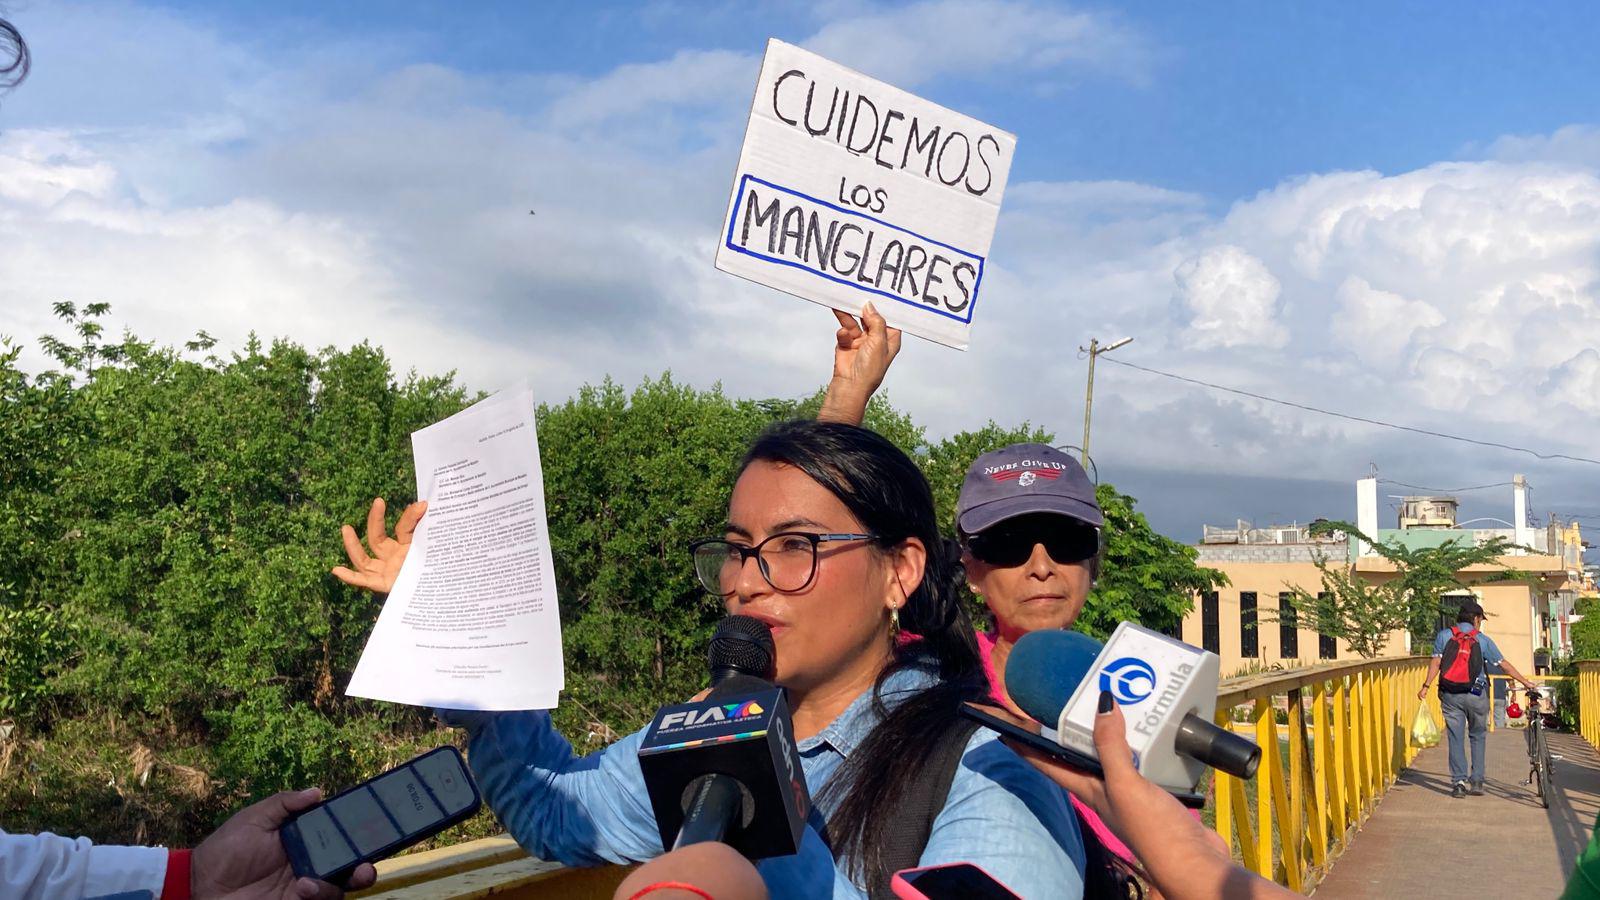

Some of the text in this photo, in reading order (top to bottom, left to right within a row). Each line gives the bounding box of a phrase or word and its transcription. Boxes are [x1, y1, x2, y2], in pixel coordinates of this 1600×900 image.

[773, 69, 1000, 196] CUIDEMOS
[839, 176, 888, 213] LOS
[741, 190, 977, 312] MANGLARES
[1133, 662, 1194, 737] Fórmula
